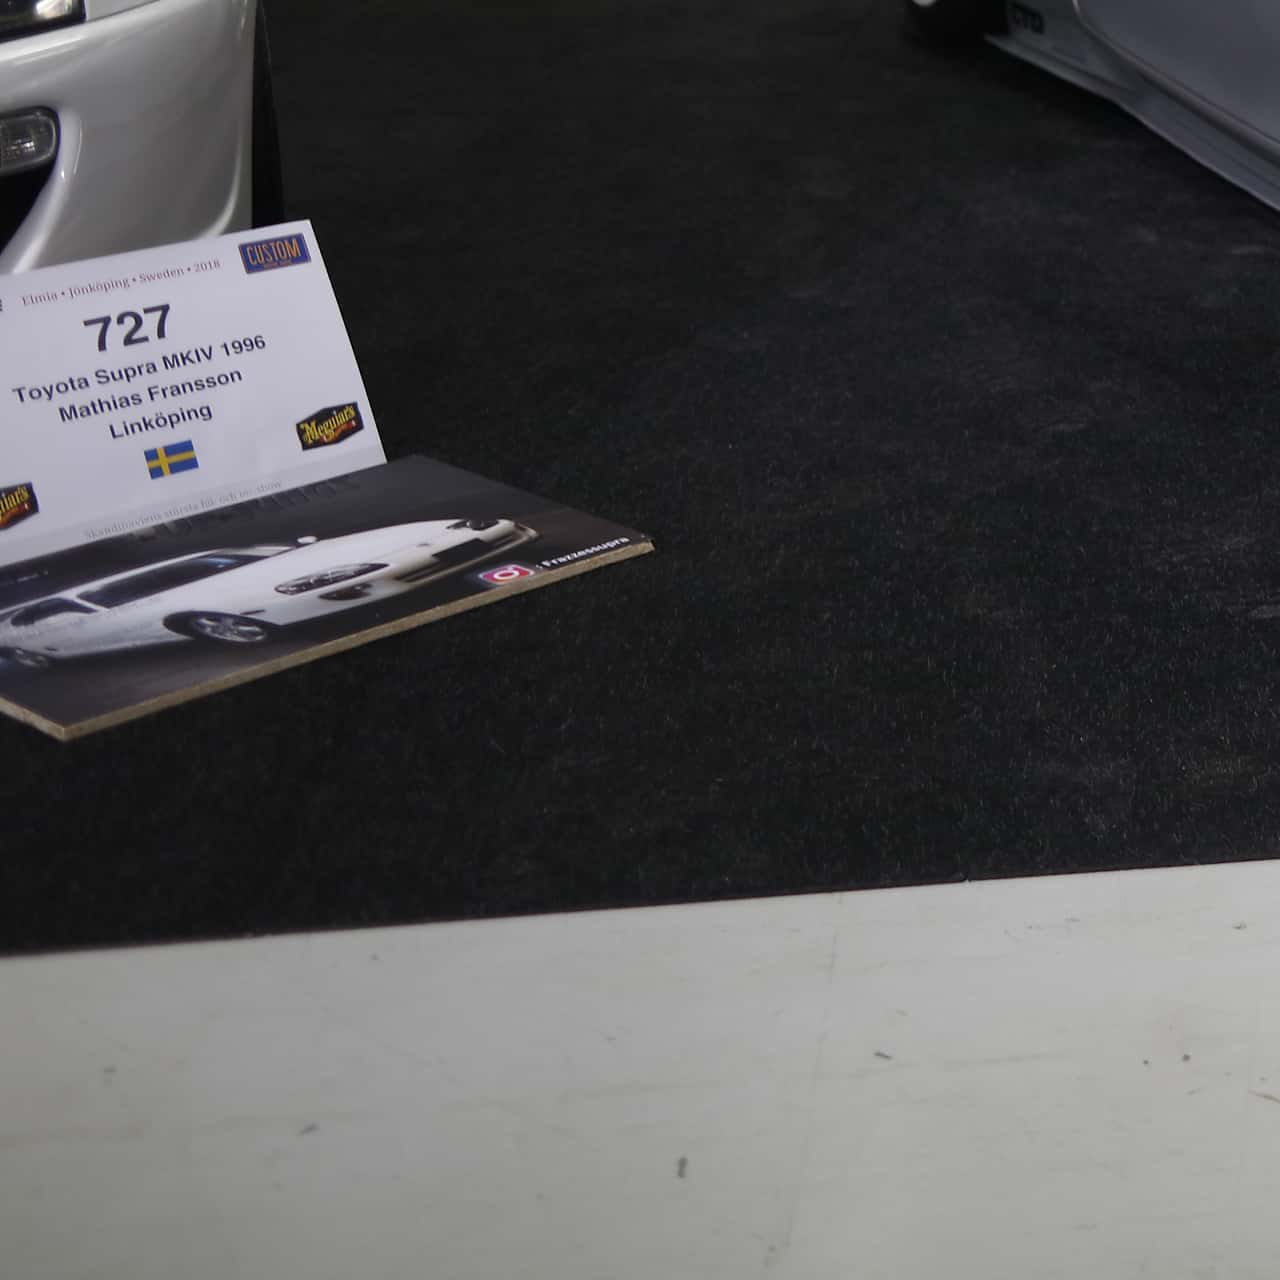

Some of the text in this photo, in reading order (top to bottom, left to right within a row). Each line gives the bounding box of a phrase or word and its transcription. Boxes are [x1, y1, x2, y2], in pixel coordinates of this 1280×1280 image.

[139, 266, 185, 284] Sweden
[194, 259, 221, 273] 2018
[246, 238, 301, 266] CUSTOM
[83, 303, 171, 352] 727
[12, 335, 266, 404] Toyota Supra MKIV 1996
[58, 369, 243, 423] Mathias Fransson
[109, 403, 213, 440] Linköping
